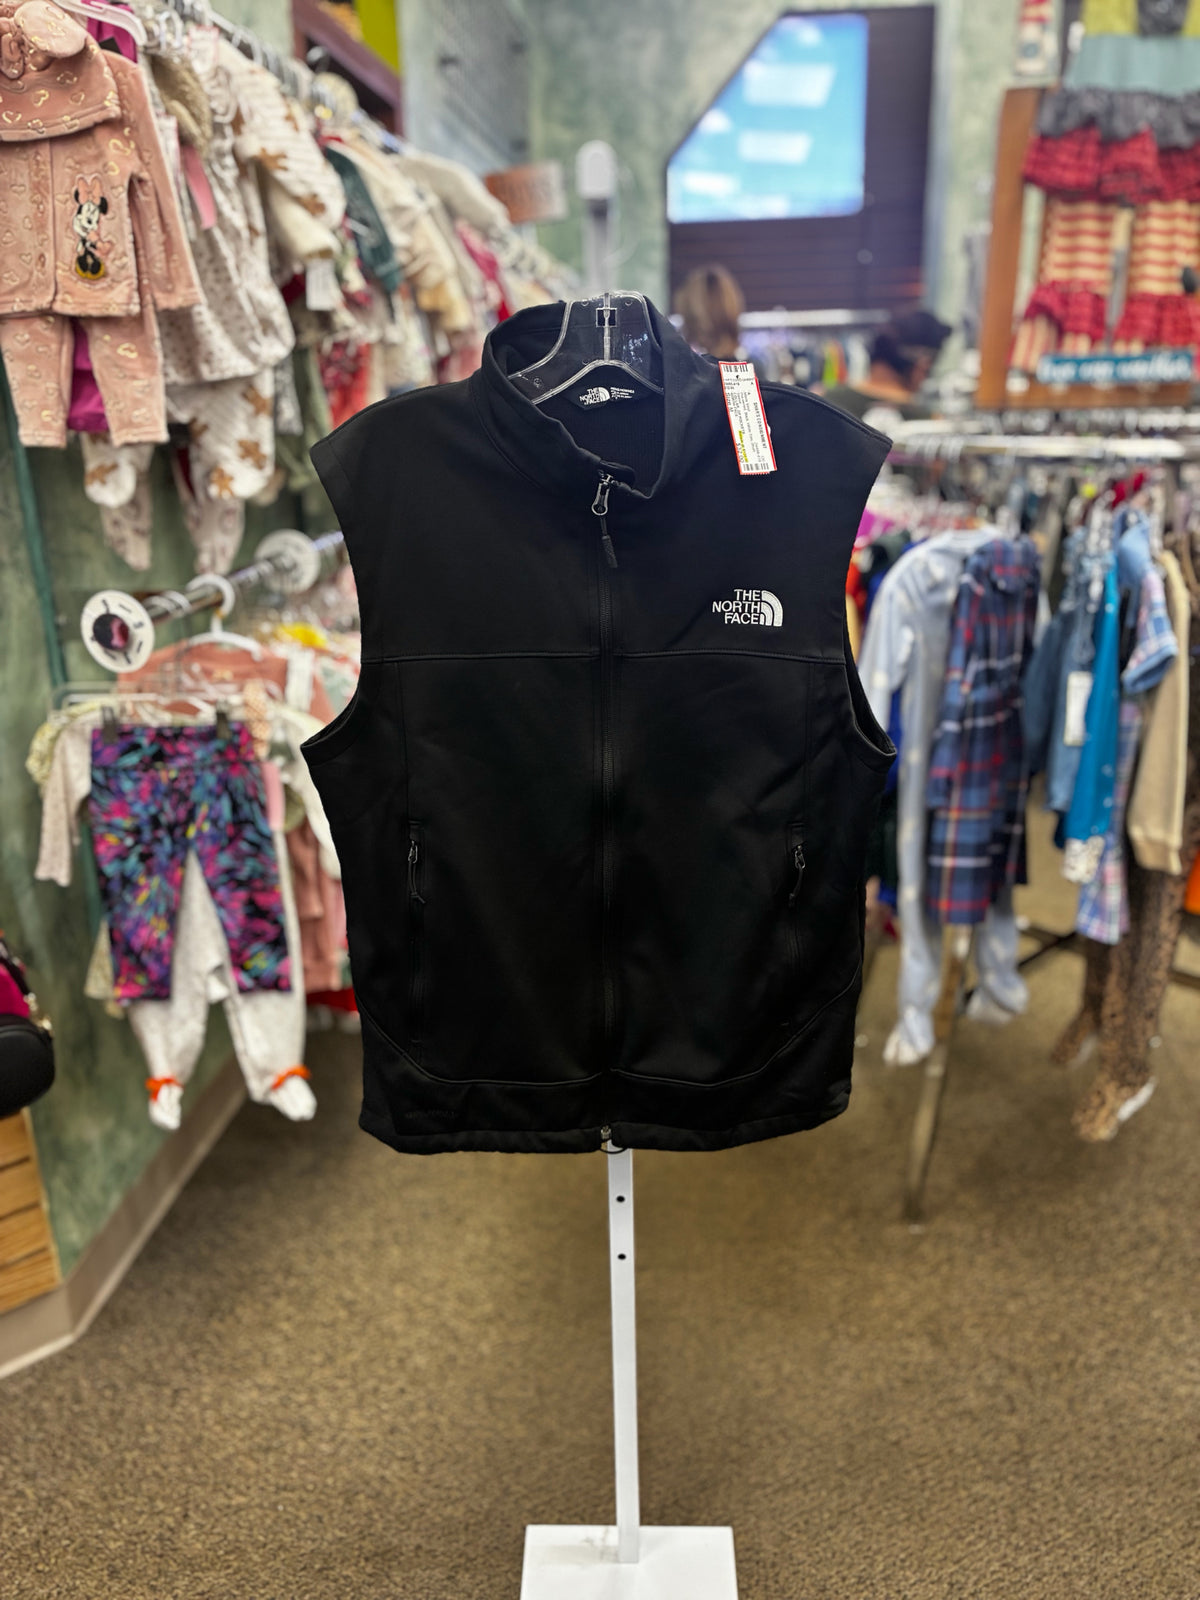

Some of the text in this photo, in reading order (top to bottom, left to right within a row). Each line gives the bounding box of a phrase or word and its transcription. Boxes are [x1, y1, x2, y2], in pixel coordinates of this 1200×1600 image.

[734, 589, 761, 601] THE
[712, 601, 760, 613] NORTH
[725, 612, 759, 624] FACE
